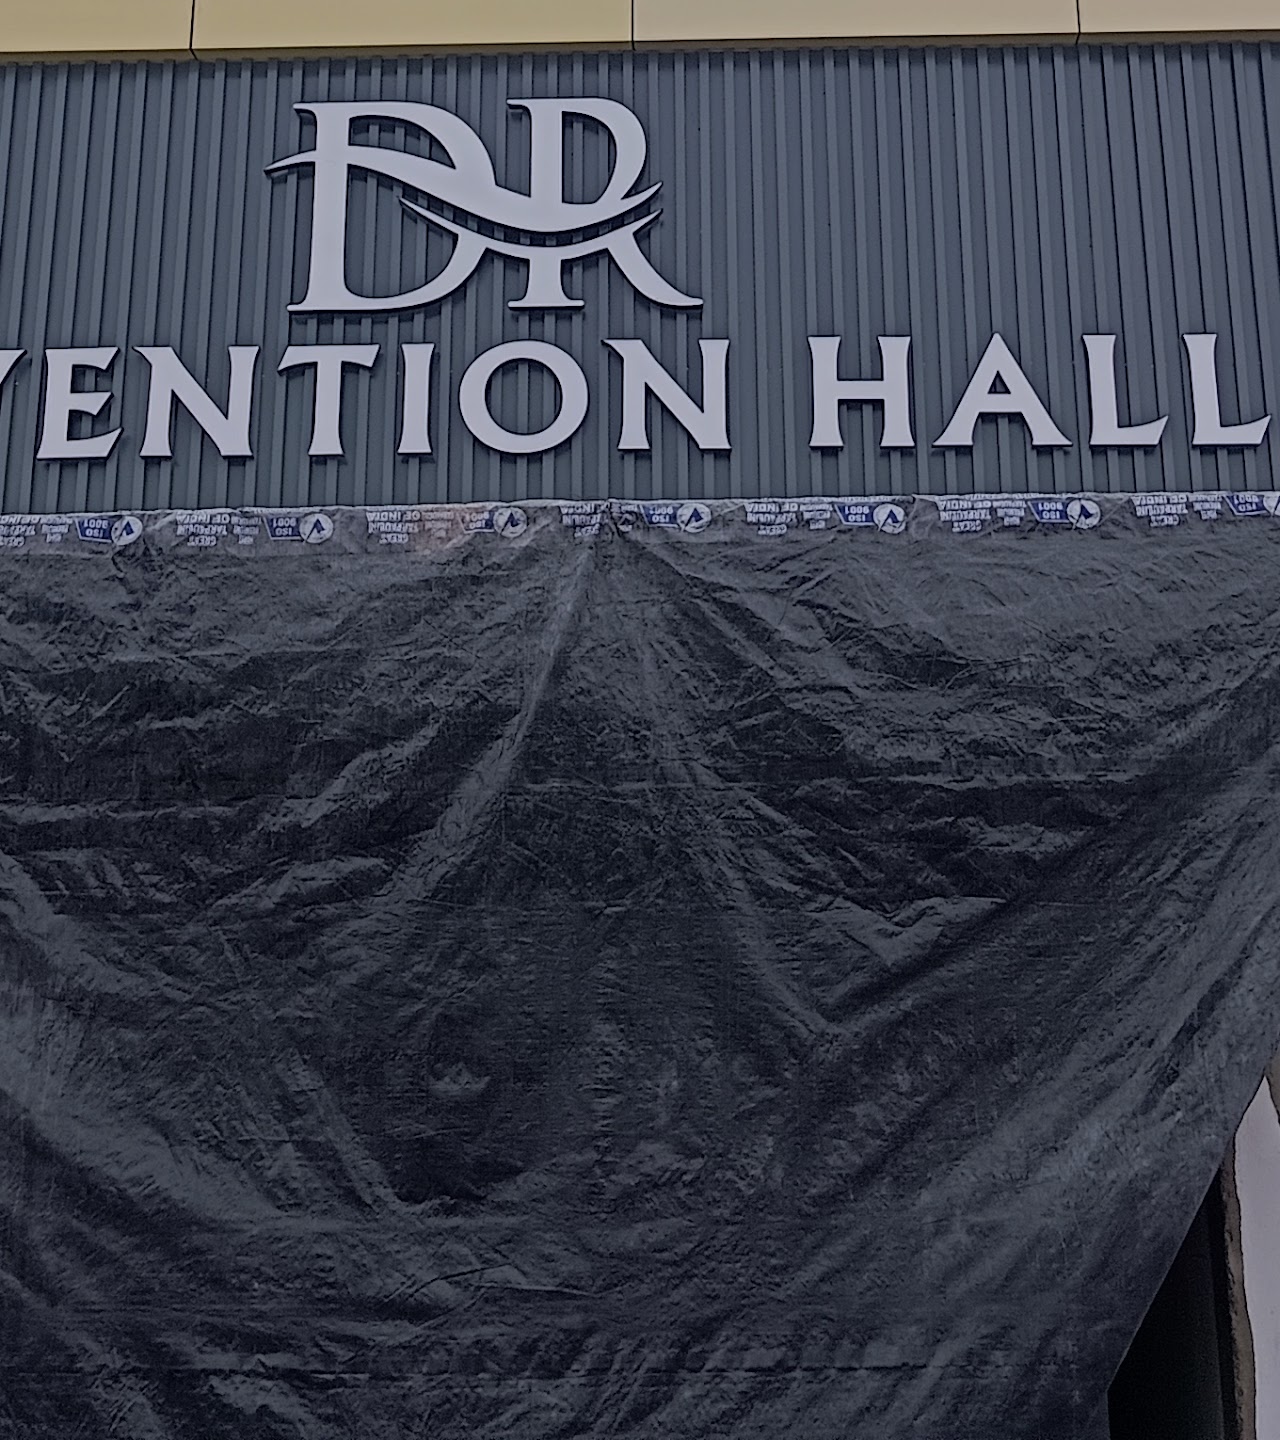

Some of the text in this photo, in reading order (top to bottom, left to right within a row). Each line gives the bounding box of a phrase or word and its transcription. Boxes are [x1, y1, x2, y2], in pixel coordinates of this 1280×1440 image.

[808, 333, 1272, 448] HALL
[744, 502, 798, 512] OF INDIA
[844, 506, 870, 514] 9001
[937, 500, 972, 510] INDIA
[1038, 502, 1063, 510] 9001
[212, 514, 230, 524] OF
[366, 511, 420, 521] OF INDIA
[1042, 510, 1060, 519] ISO
[84, 520, 108, 528] 9001
[272, 518, 296, 526] 9001
[952, 520, 982, 532] GREAT
[86, 529, 103, 537] ISO
[276, 527, 292, 536] ISO
[758, 524, 787, 535] GREAT
[188, 536, 216, 546] GREAT
[379, 534, 408, 544] GREAT
